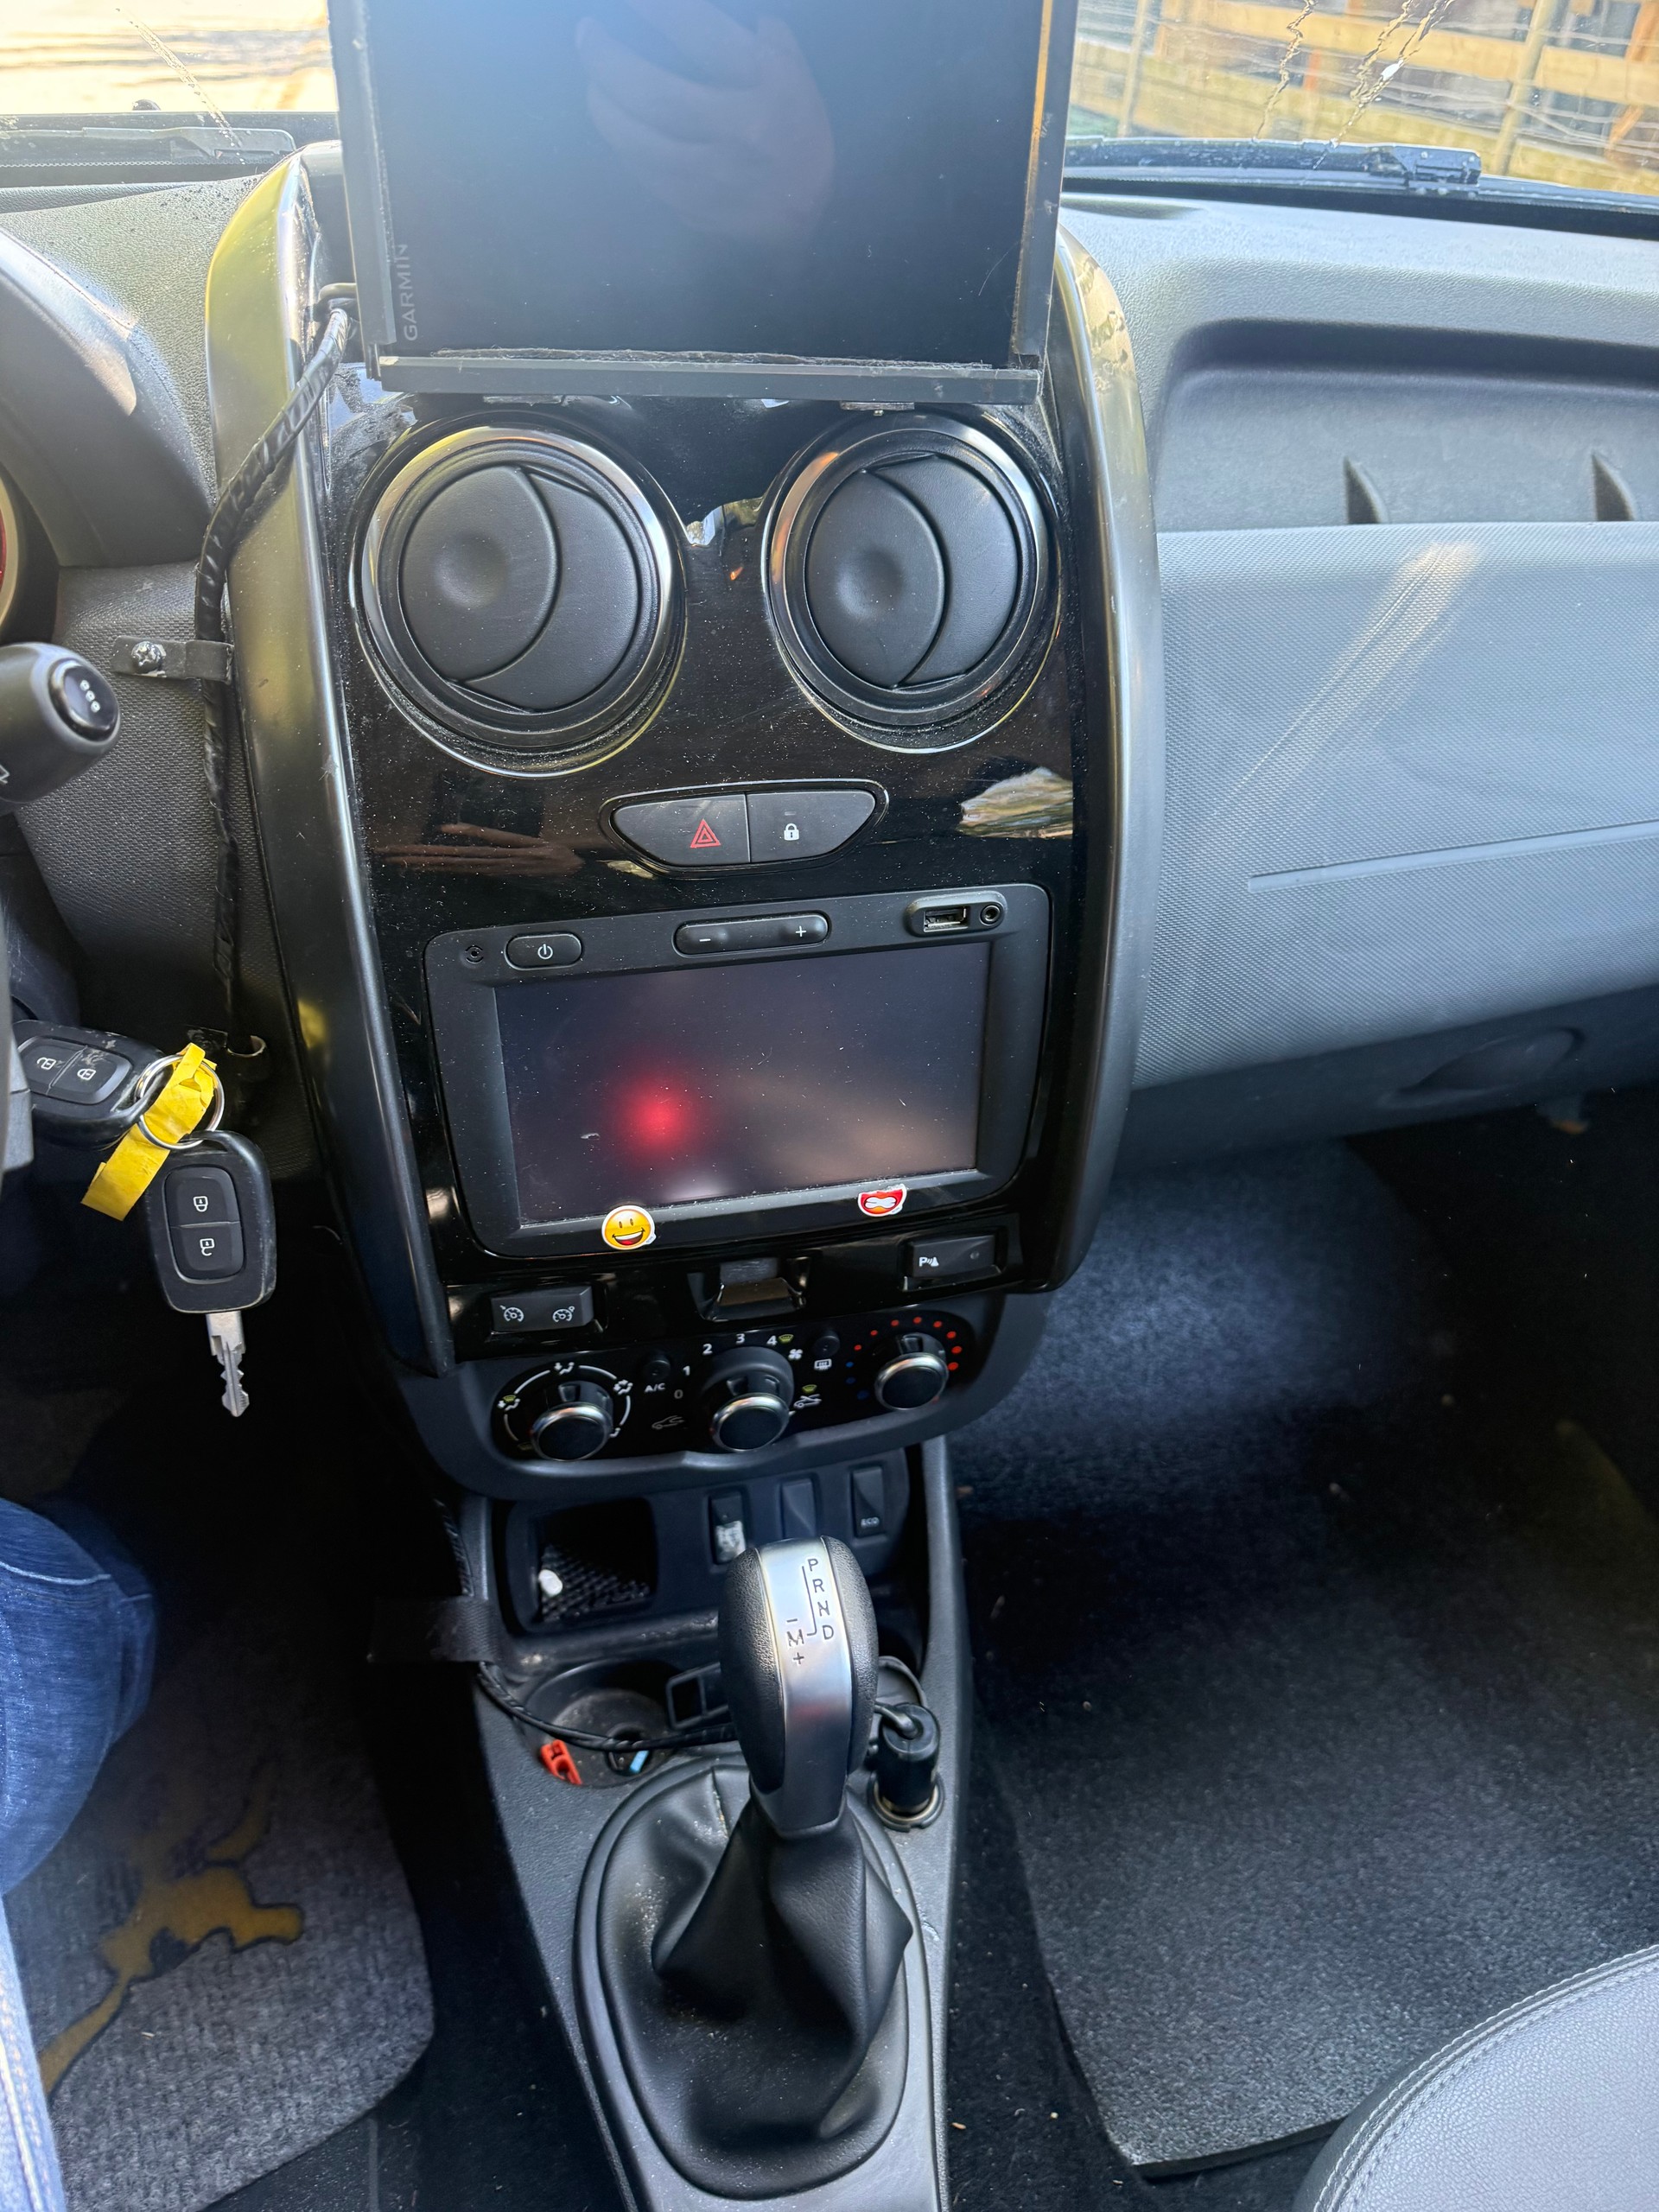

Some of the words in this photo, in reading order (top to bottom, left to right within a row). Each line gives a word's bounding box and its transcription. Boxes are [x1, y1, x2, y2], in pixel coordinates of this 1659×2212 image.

[394, 244, 418, 341] GARMIN
[735, 1333, 745, 1344] 3
[766, 1335, 778, 1346] 4
[702, 1343, 713, 1356] 2
[683, 1365, 690, 1376] 1
[644, 1382, 666, 1393] A/C
[807, 1558, 819, 1572] P
[812, 1578, 825, 1593] R
[817, 1600, 830, 1617] N
[786, 1629, 804, 1647] M
[822, 1624, 835, 1640] D
